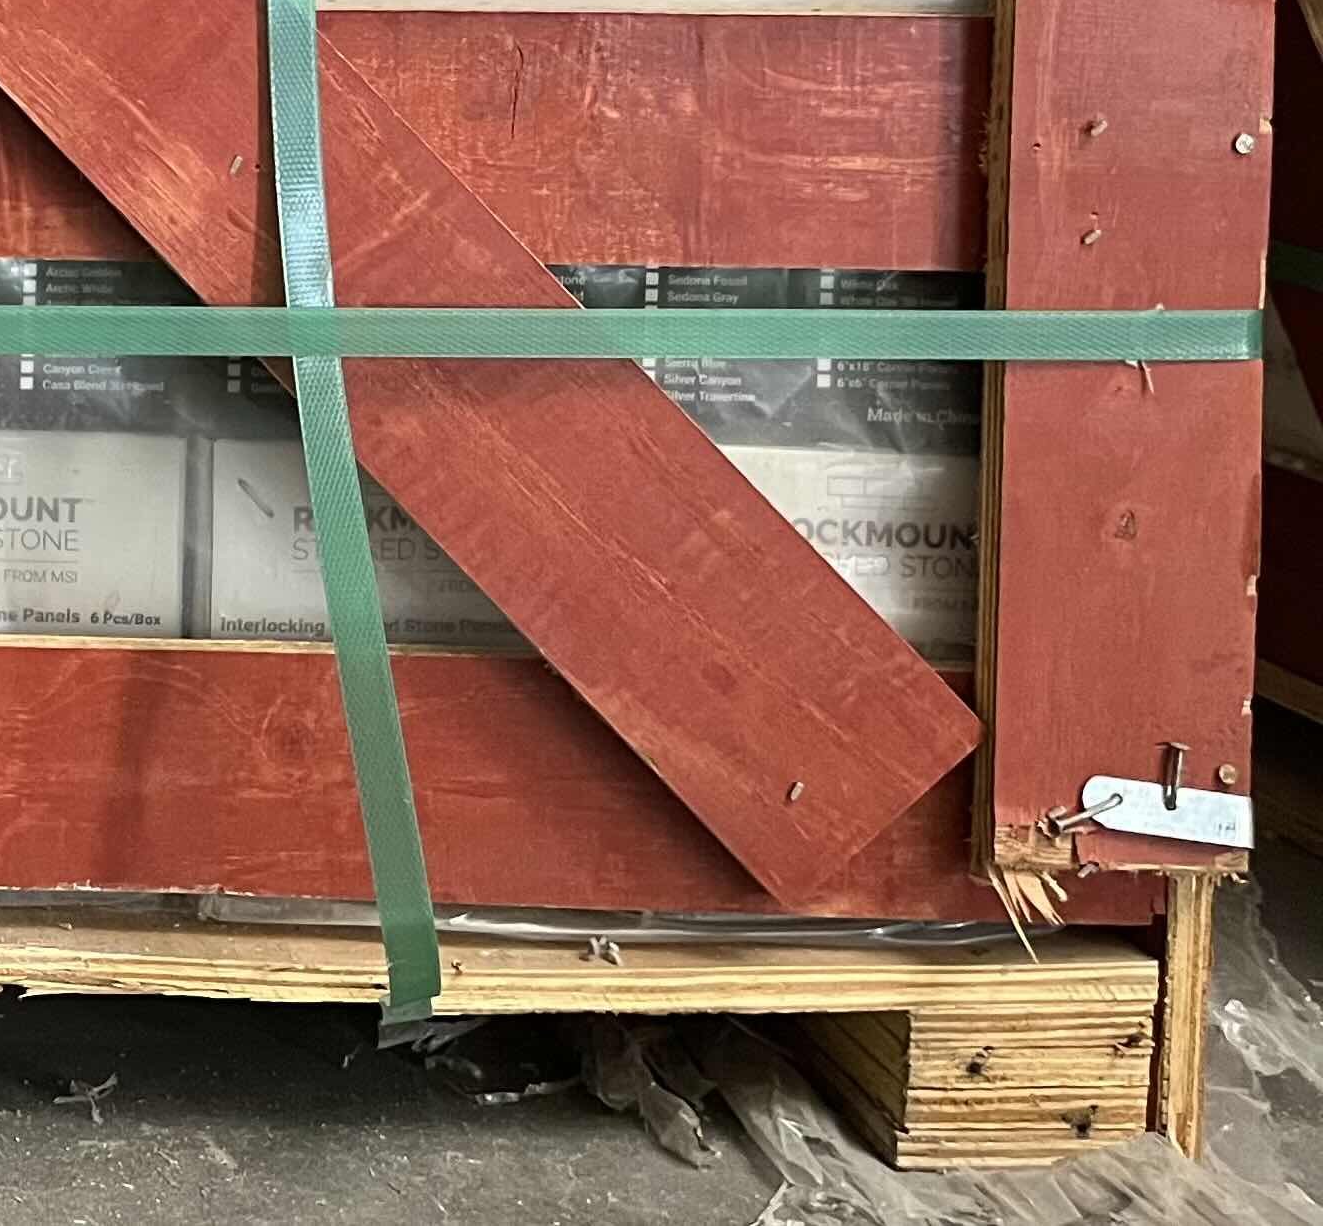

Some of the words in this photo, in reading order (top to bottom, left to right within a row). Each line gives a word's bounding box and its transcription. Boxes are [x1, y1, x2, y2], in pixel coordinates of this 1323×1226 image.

[713, 292, 739, 304] Gray
[4, 569, 46, 582] FROM
[51, 571, 78, 583] MSI
[22, 608, 80, 625] Panels
[90, 612, 99, 625] 6
[102, 612, 161, 626] Pcs/Box
[220, 617, 326, 637] Interlocking
